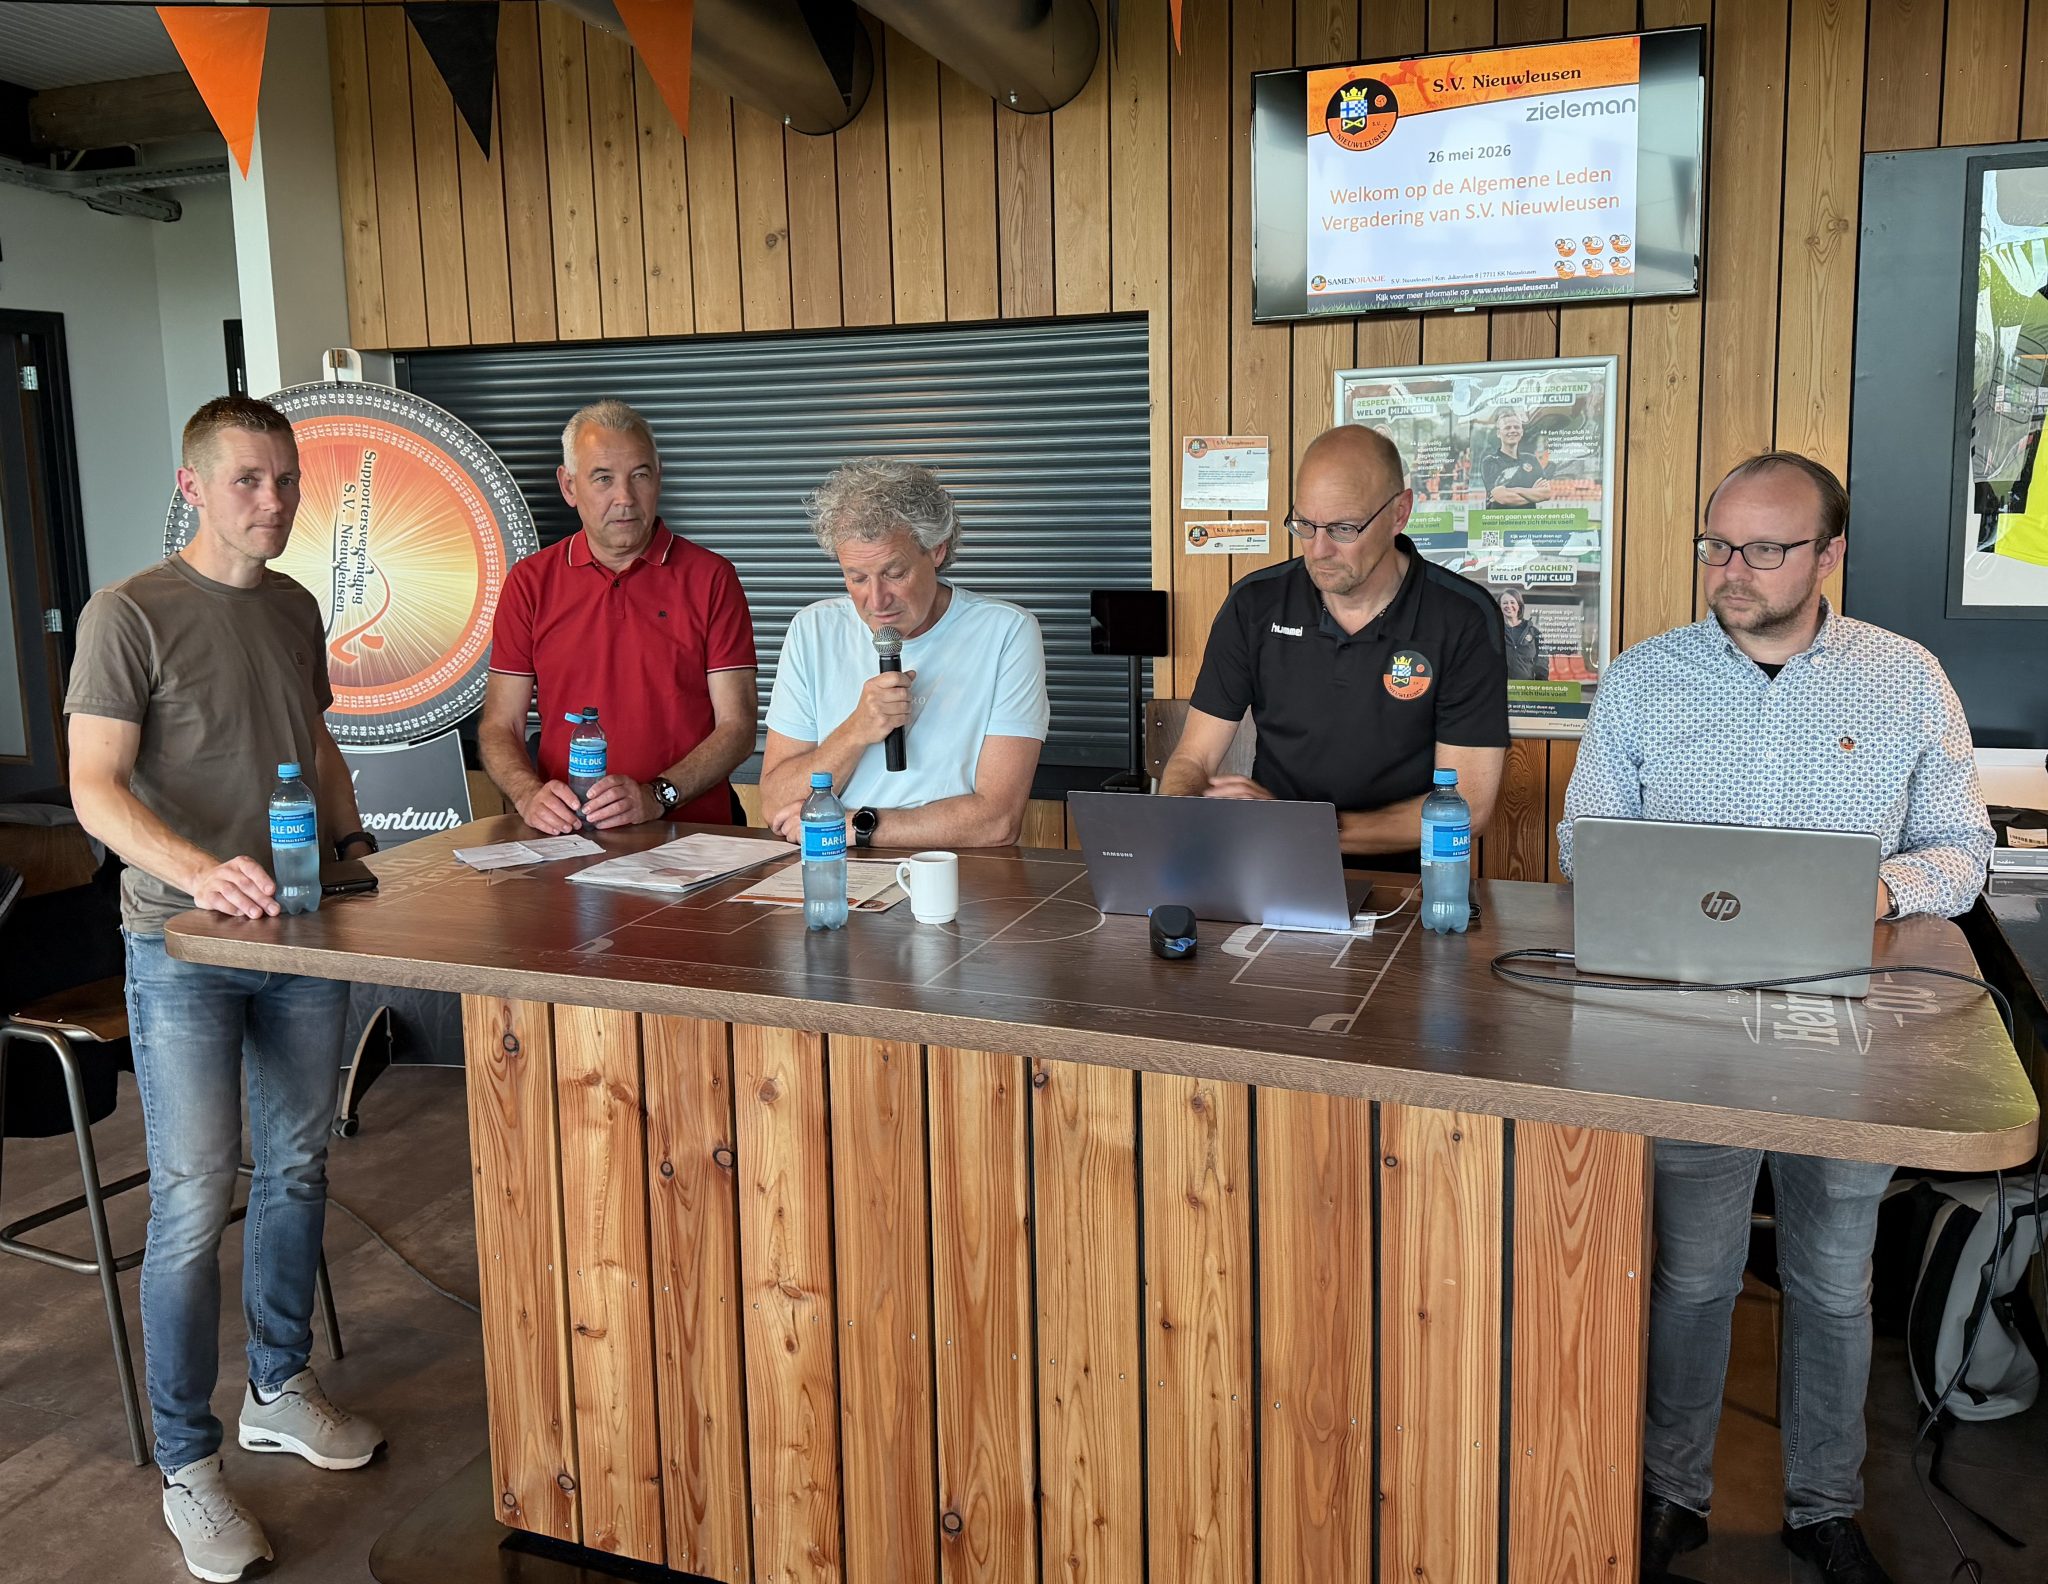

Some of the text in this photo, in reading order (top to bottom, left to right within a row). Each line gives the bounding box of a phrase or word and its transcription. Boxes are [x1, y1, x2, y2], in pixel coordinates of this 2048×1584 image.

[1432, 69, 1581, 93] S.V. Nieuwleusen
[1525, 97, 1636, 122] zieleman
[1428, 144, 1511, 163] 26 mei 2026
[1330, 167, 1611, 205] Welkom op de Algemene Leden
[1322, 196, 1620, 232] Vergadering van S.V. Nieuwleusen
[1375, 293, 1388, 302] Kijk
[1424, 289, 1459, 298] informatie
[1460, 290, 1469, 298] op
[1472, 281, 1559, 295] www.svnieuwleusen.nl
[301, 396, 310, 408] 24
[310, 395, 319, 406] 85
[319, 394, 328, 405] 26
[328, 393, 337, 404] 87
[337, 393, 345, 404] 28
[346, 393, 354, 405] 89
[355, 394, 364, 406] 30
[364, 395, 373, 406] 91
[373, 397, 382, 409] 32
[1357, 399, 1389, 407] RESPECT
[1549, 394, 1570, 402] CLUB
[283, 401, 293, 413] 22
[292, 398, 302, 410] 83
[382, 399, 391, 410] 93
[391, 401, 400, 413] 34
[399, 405, 409, 416] 95
[408, 408, 418, 420] 36
[1357, 409, 1373, 417] WEL
[1411, 405, 1432, 413] CLUB
[416, 412, 426, 424] 97
[424, 416, 435, 428] 38
[432, 422, 443, 433] 99
[440, 427, 450, 438] 40
[446, 430, 459, 445] 101
[454, 438, 465, 449] 42
[459, 443, 474, 457] 103
[468, 451, 478, 462] 44
[472, 456, 487, 470] 105
[480, 465, 490, 475] 46
[484, 471, 498, 484] 107
[490, 480, 501, 490] 48
[493, 487, 508, 499] 109
[499, 496, 511, 505] 50
[182, 503, 194, 512] 65
[501, 503, 517, 514] 111
[183, 512, 189, 520] 4
[506, 512, 518, 522] 52
[178, 520, 190, 528] 63
[352, 450, 377, 605] Supportersvereniging
[507, 520, 523, 530] 113
[513, 529, 524, 538] 54
[176, 537, 186, 545] 61
[512, 538, 528, 547] 115
[335, 483, 357, 613] S.V. Nieuwleusen
[516, 547, 527, 555] 56
[1529, 564, 1573, 572] COACHEN?
[1271, 622, 1303, 637] hummel
[475, 678, 486, 688] 13
[462, 689, 473, 700] 15
[469, 684, 480, 695] 74
[449, 700, 459, 710] 17
[455, 694, 466, 706] 76
[434, 708, 444, 718] 19
[441, 703, 452, 715] 78
[419, 715, 428, 726] 21
[426, 711, 436, 722] 80
[394, 722, 403, 733] 84
[402, 720, 412, 731] 23
[410, 717, 420, 728] 82
[332, 725, 341, 735] 31
[341, 725, 349, 736] 90
[351, 725, 358, 736] 29
[359, 726, 367, 737] 88
[368, 726, 376, 736] 27
[377, 724, 385, 736] 86
[385, 723, 394, 734] 25
[589, 757, 602, 766] DUC
[286, 824, 305, 834] DUC
[1704, 891, 1738, 922] hp
